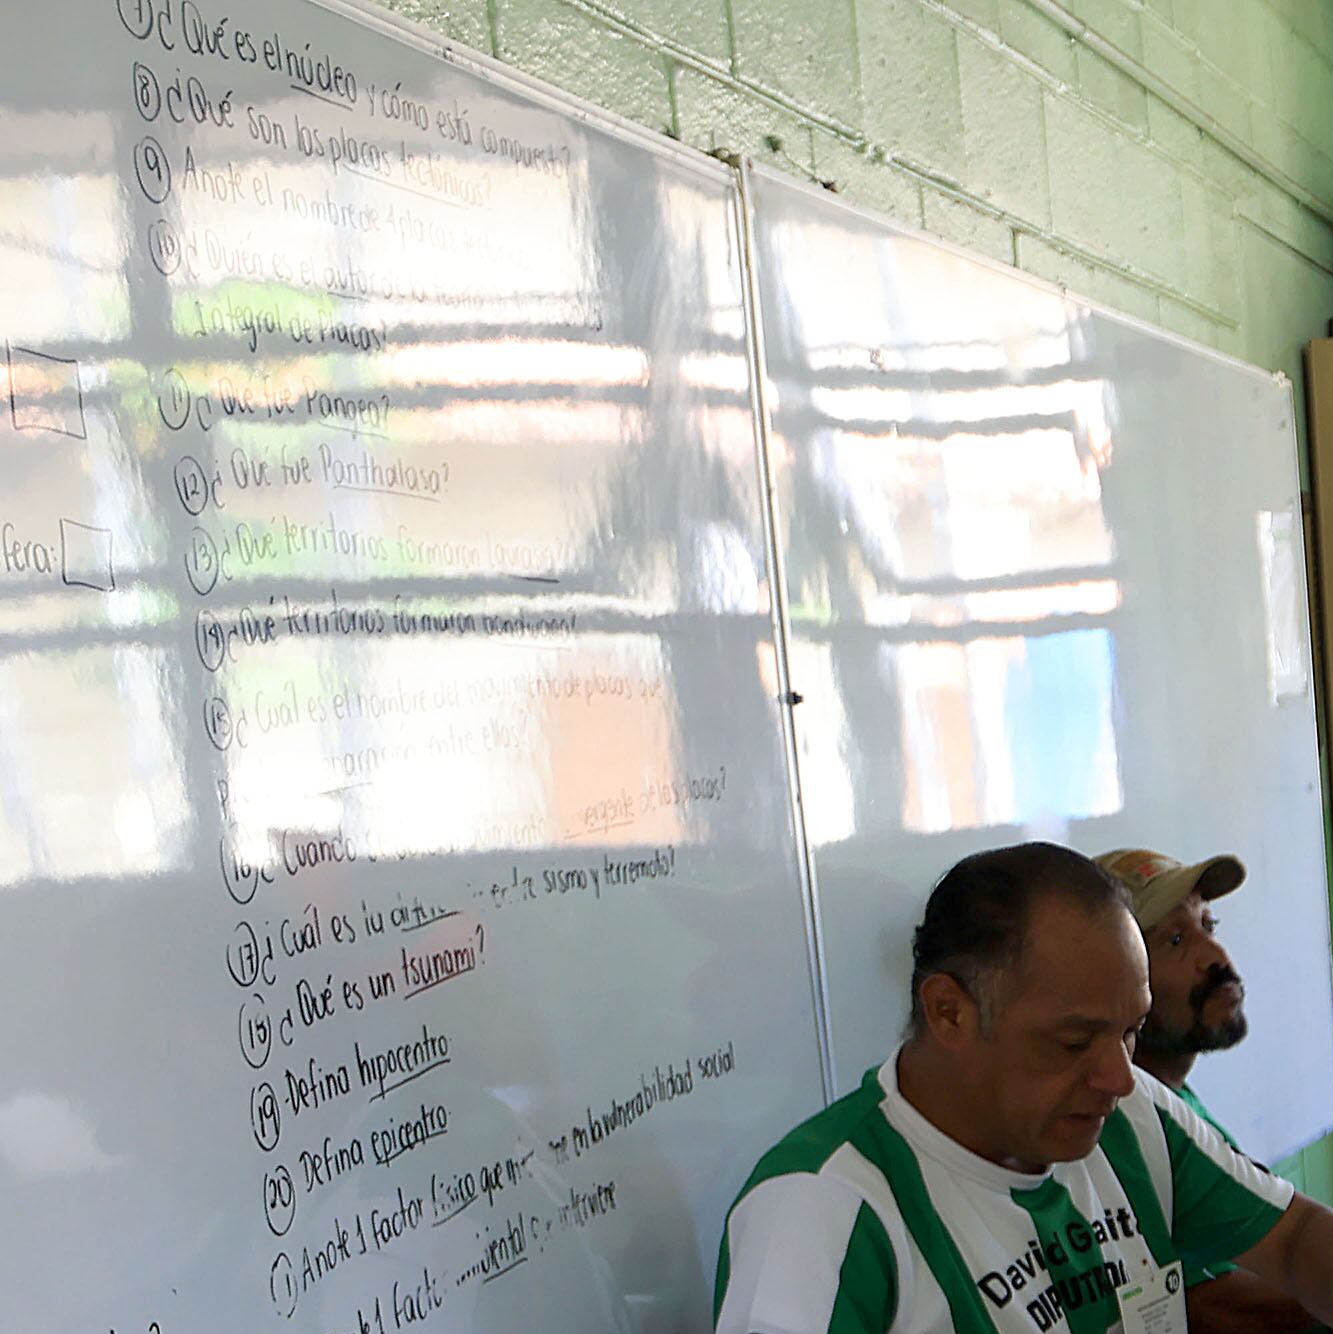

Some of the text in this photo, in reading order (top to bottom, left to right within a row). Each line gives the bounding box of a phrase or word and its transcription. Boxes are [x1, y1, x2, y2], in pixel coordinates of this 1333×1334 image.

[235, 30, 257, 63] es
[263, 34, 282, 71] el
[286, 43, 358, 104] núcleo
[382, 82, 429, 131] cómo
[436, 99, 472, 146] está
[247, 107, 287, 150] son
[329, 127, 392, 177] placas
[183, 146, 245, 201] Anote
[252, 173, 274, 206] el
[283, 188, 357, 230] nombre
[280, 444, 312, 486] fue
[283, 511, 389, 562] territorios
[307, 696, 327, 723] es
[332, 681, 352, 720] el
[331, 914, 356, 943] es
[343, 981, 364, 1011] es
[368, 971, 396, 1000] un
[401, 923, 486, 987] tsunami?
[298, 1137, 365, 1193] Defina
[302, 1218, 351, 1293] Anote
[371, 1187, 424, 1250] factor
[697, 1040, 737, 1080] social
[977, 1231, 1069, 1309] David
